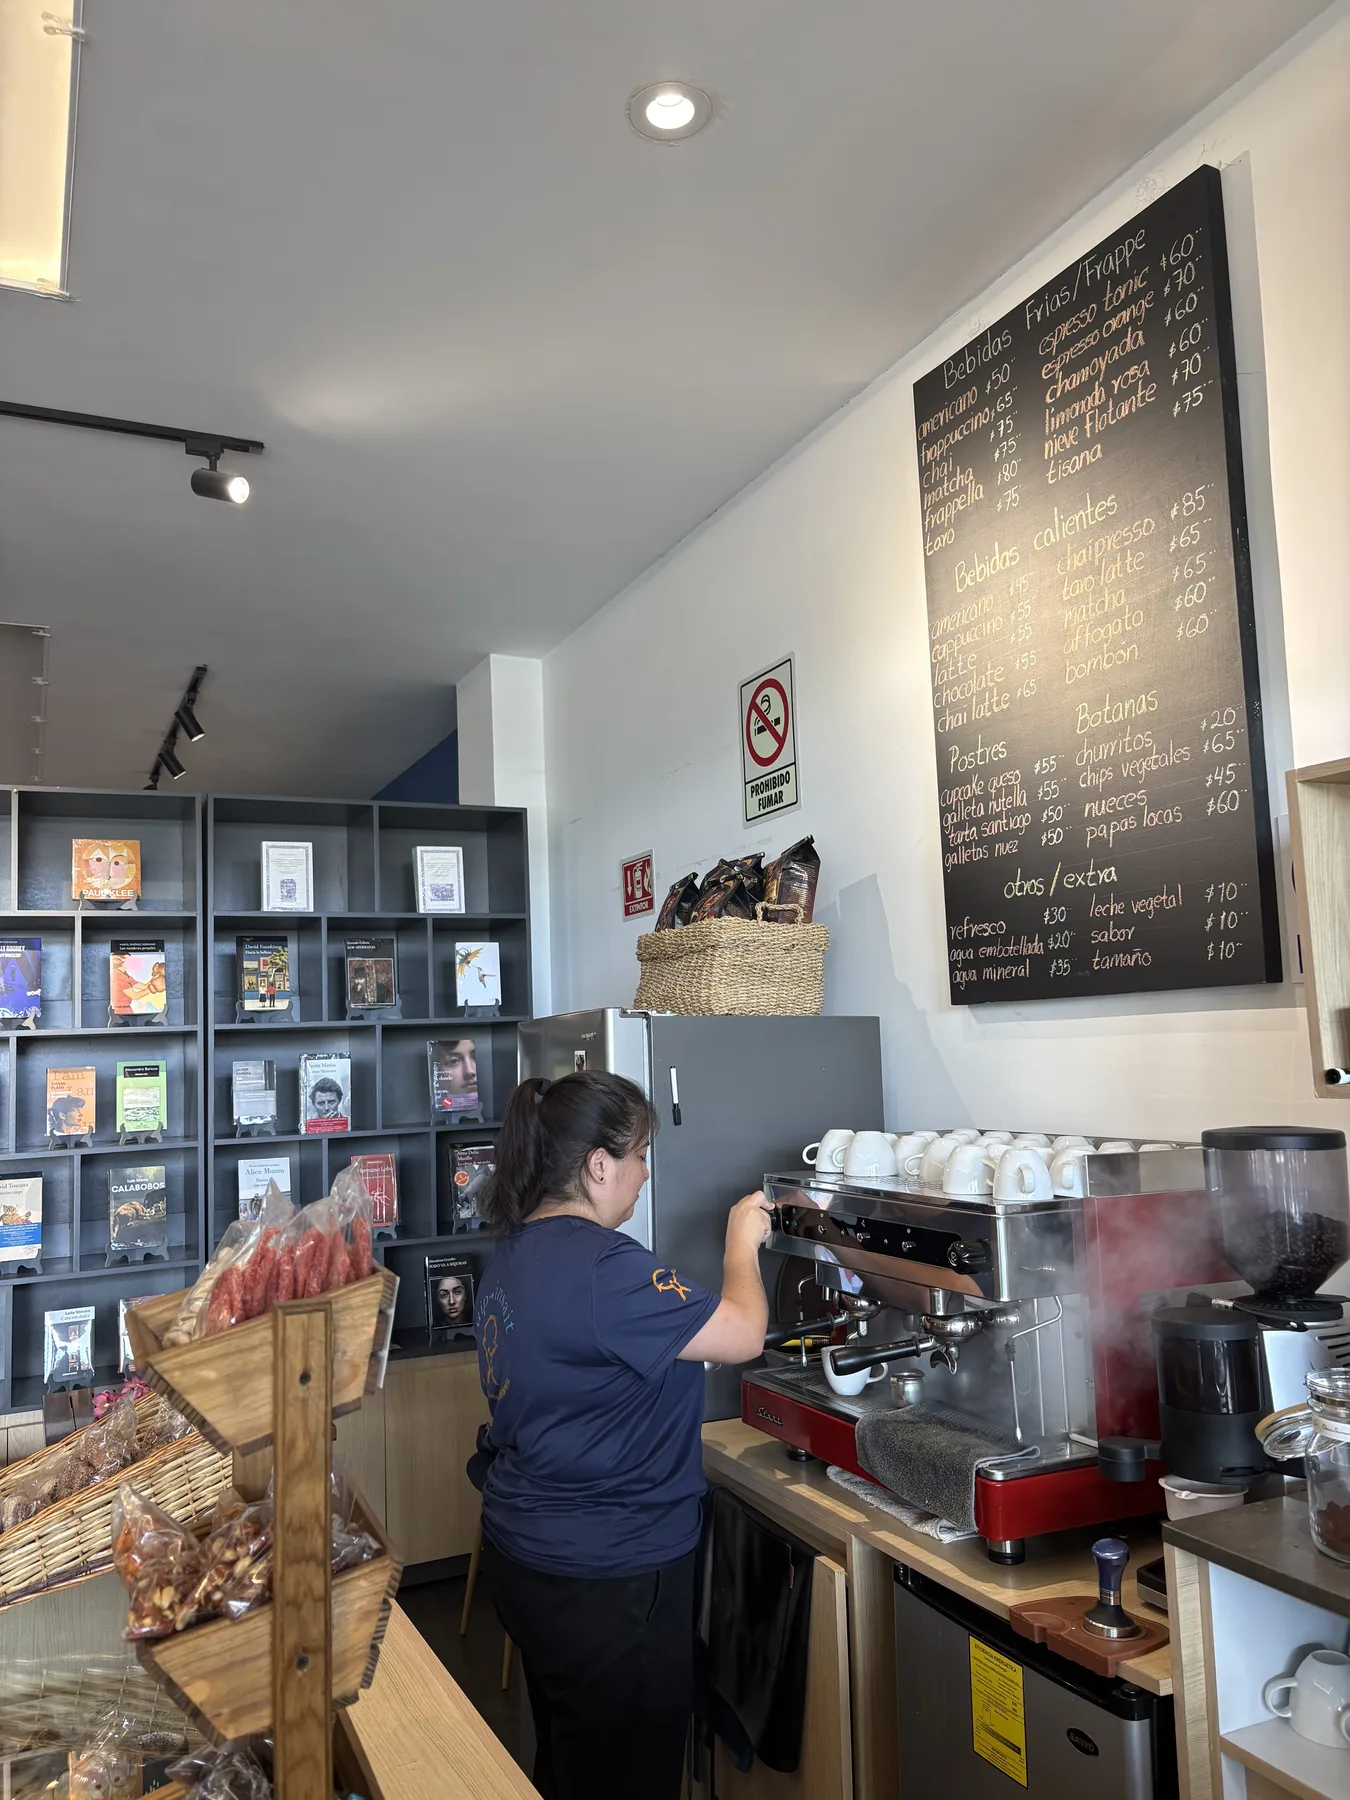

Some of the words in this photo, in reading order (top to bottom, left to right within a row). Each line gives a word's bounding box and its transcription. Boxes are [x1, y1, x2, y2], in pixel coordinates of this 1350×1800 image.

[1039, 304, 1097, 355] espresso
[1102, 266, 1149, 311] tonic
[1041, 329, 1100, 379] espresso
[1102, 291, 1154, 337] orange
[943, 331, 1013, 389] Bebidas
[1045, 327, 1145, 403] chamoyada
[1111, 360, 1150, 394] rosa
[917, 386, 978, 440] americano
[920, 406, 990, 467] frappuccino
[1044, 427, 1078, 459] nieve
[923, 453, 953, 488] chai
[1046, 443, 1102, 483] tisana
[923, 466, 974, 510] matcha
[955, 542, 1020, 593] Bebidas
[1033, 492, 1118, 550] calientes
[1100, 549, 1145, 585] latte
[931, 595, 993, 640] americano
[1064, 587, 1124, 629] matcha
[931, 615, 1003, 663] cappuccino
[934, 653, 977, 686] latte
[934, 662, 1005, 708] chocolate
[937, 709, 967, 733] chai
[972, 687, 1010, 720] latte
[1076, 690, 1158, 734] Botanas
[949, 735, 1007, 773] Postres
[1075, 725, 1153, 766] churritos
[750, 770, 791, 798] PROHIBIDO
[1079, 765, 1114, 792] chips
[1121, 739, 1190, 783] vegetales
[758, 790, 784, 812] FUMAR
[942, 799, 984, 834] galleta
[988, 785, 1027, 815] nutella
[1084, 789, 1147, 818] nueces
[949, 822, 978, 847] tarta
[1086, 816, 1137, 848] papas
[1143, 805, 1182, 827] locas
[944, 842, 988, 872] galletas
[995, 840, 1019, 857] nuez
[1063, 858, 1118, 888] extra
[109, 889, 134, 897] KLEE
[1090, 893, 1125, 917] leche
[1131, 884, 1182, 919] vegetal
[950, 916, 1006, 940] refresco
[1091, 921, 1135, 943] sabor
[950, 949, 974, 967] agua
[978, 933, 1044, 958] embotellada
[1092, 948, 1152, 970] tamaño
[952, 971, 977, 990] agua
[982, 958, 1030, 981] mineral
[111, 1182, 166, 1193] CALABOBOS
[245, 1168, 263, 1176] Alice
